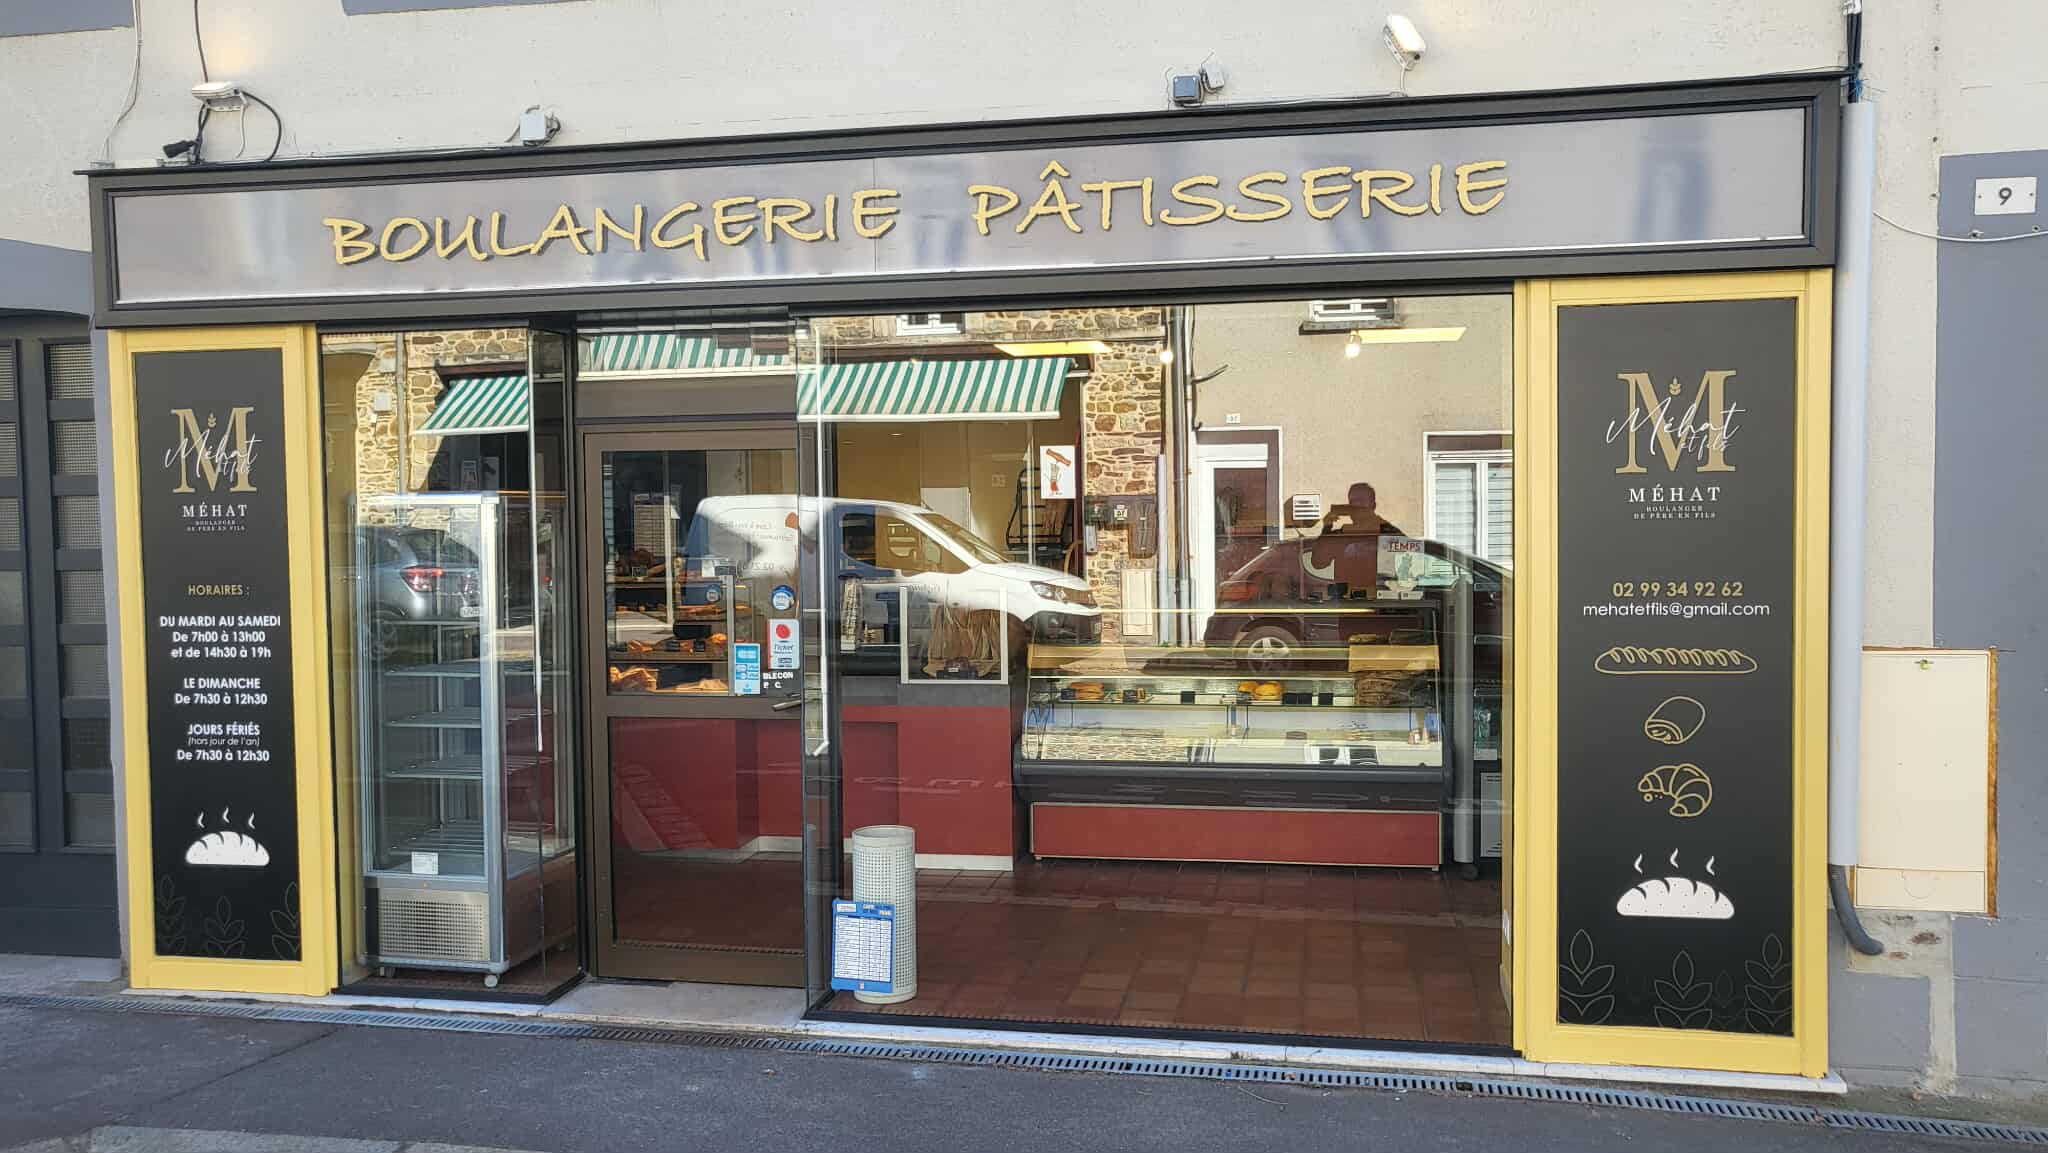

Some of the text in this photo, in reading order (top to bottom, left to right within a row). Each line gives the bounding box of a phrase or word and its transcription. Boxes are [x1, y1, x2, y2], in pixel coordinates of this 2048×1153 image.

[1998, 187, 2013, 207] 9
[323, 160, 1508, 264] BOULANGERIE PÂTISSERIE
[1606, 396, 1746, 456] Méhat
[164, 427, 262, 479] Méhat
[1628, 483, 1721, 503] MÉHAT
[183, 500, 248, 518] MÉHAT
[188, 584, 243, 596] HORAIRES
[1612, 581, 1743, 598] 02 99 34 92 62
[1583, 602, 1771, 618] mehatetfils@gmail.com
[160, 615, 281, 627] DU MARDI AU SAMEDI
[172, 630, 266, 642] De 7h00 à 13h00
[171, 645, 272, 658] et de 14h30 à 19h
[183, 677, 261, 689] LE DIMANCHE
[174, 692, 268, 704] De 7h30 à 12h30
[187, 721, 261, 735] JOURS FÉRIÉS
[226, 737, 239, 746] de
[176, 748, 270, 761] De 7h30 à 12h30
